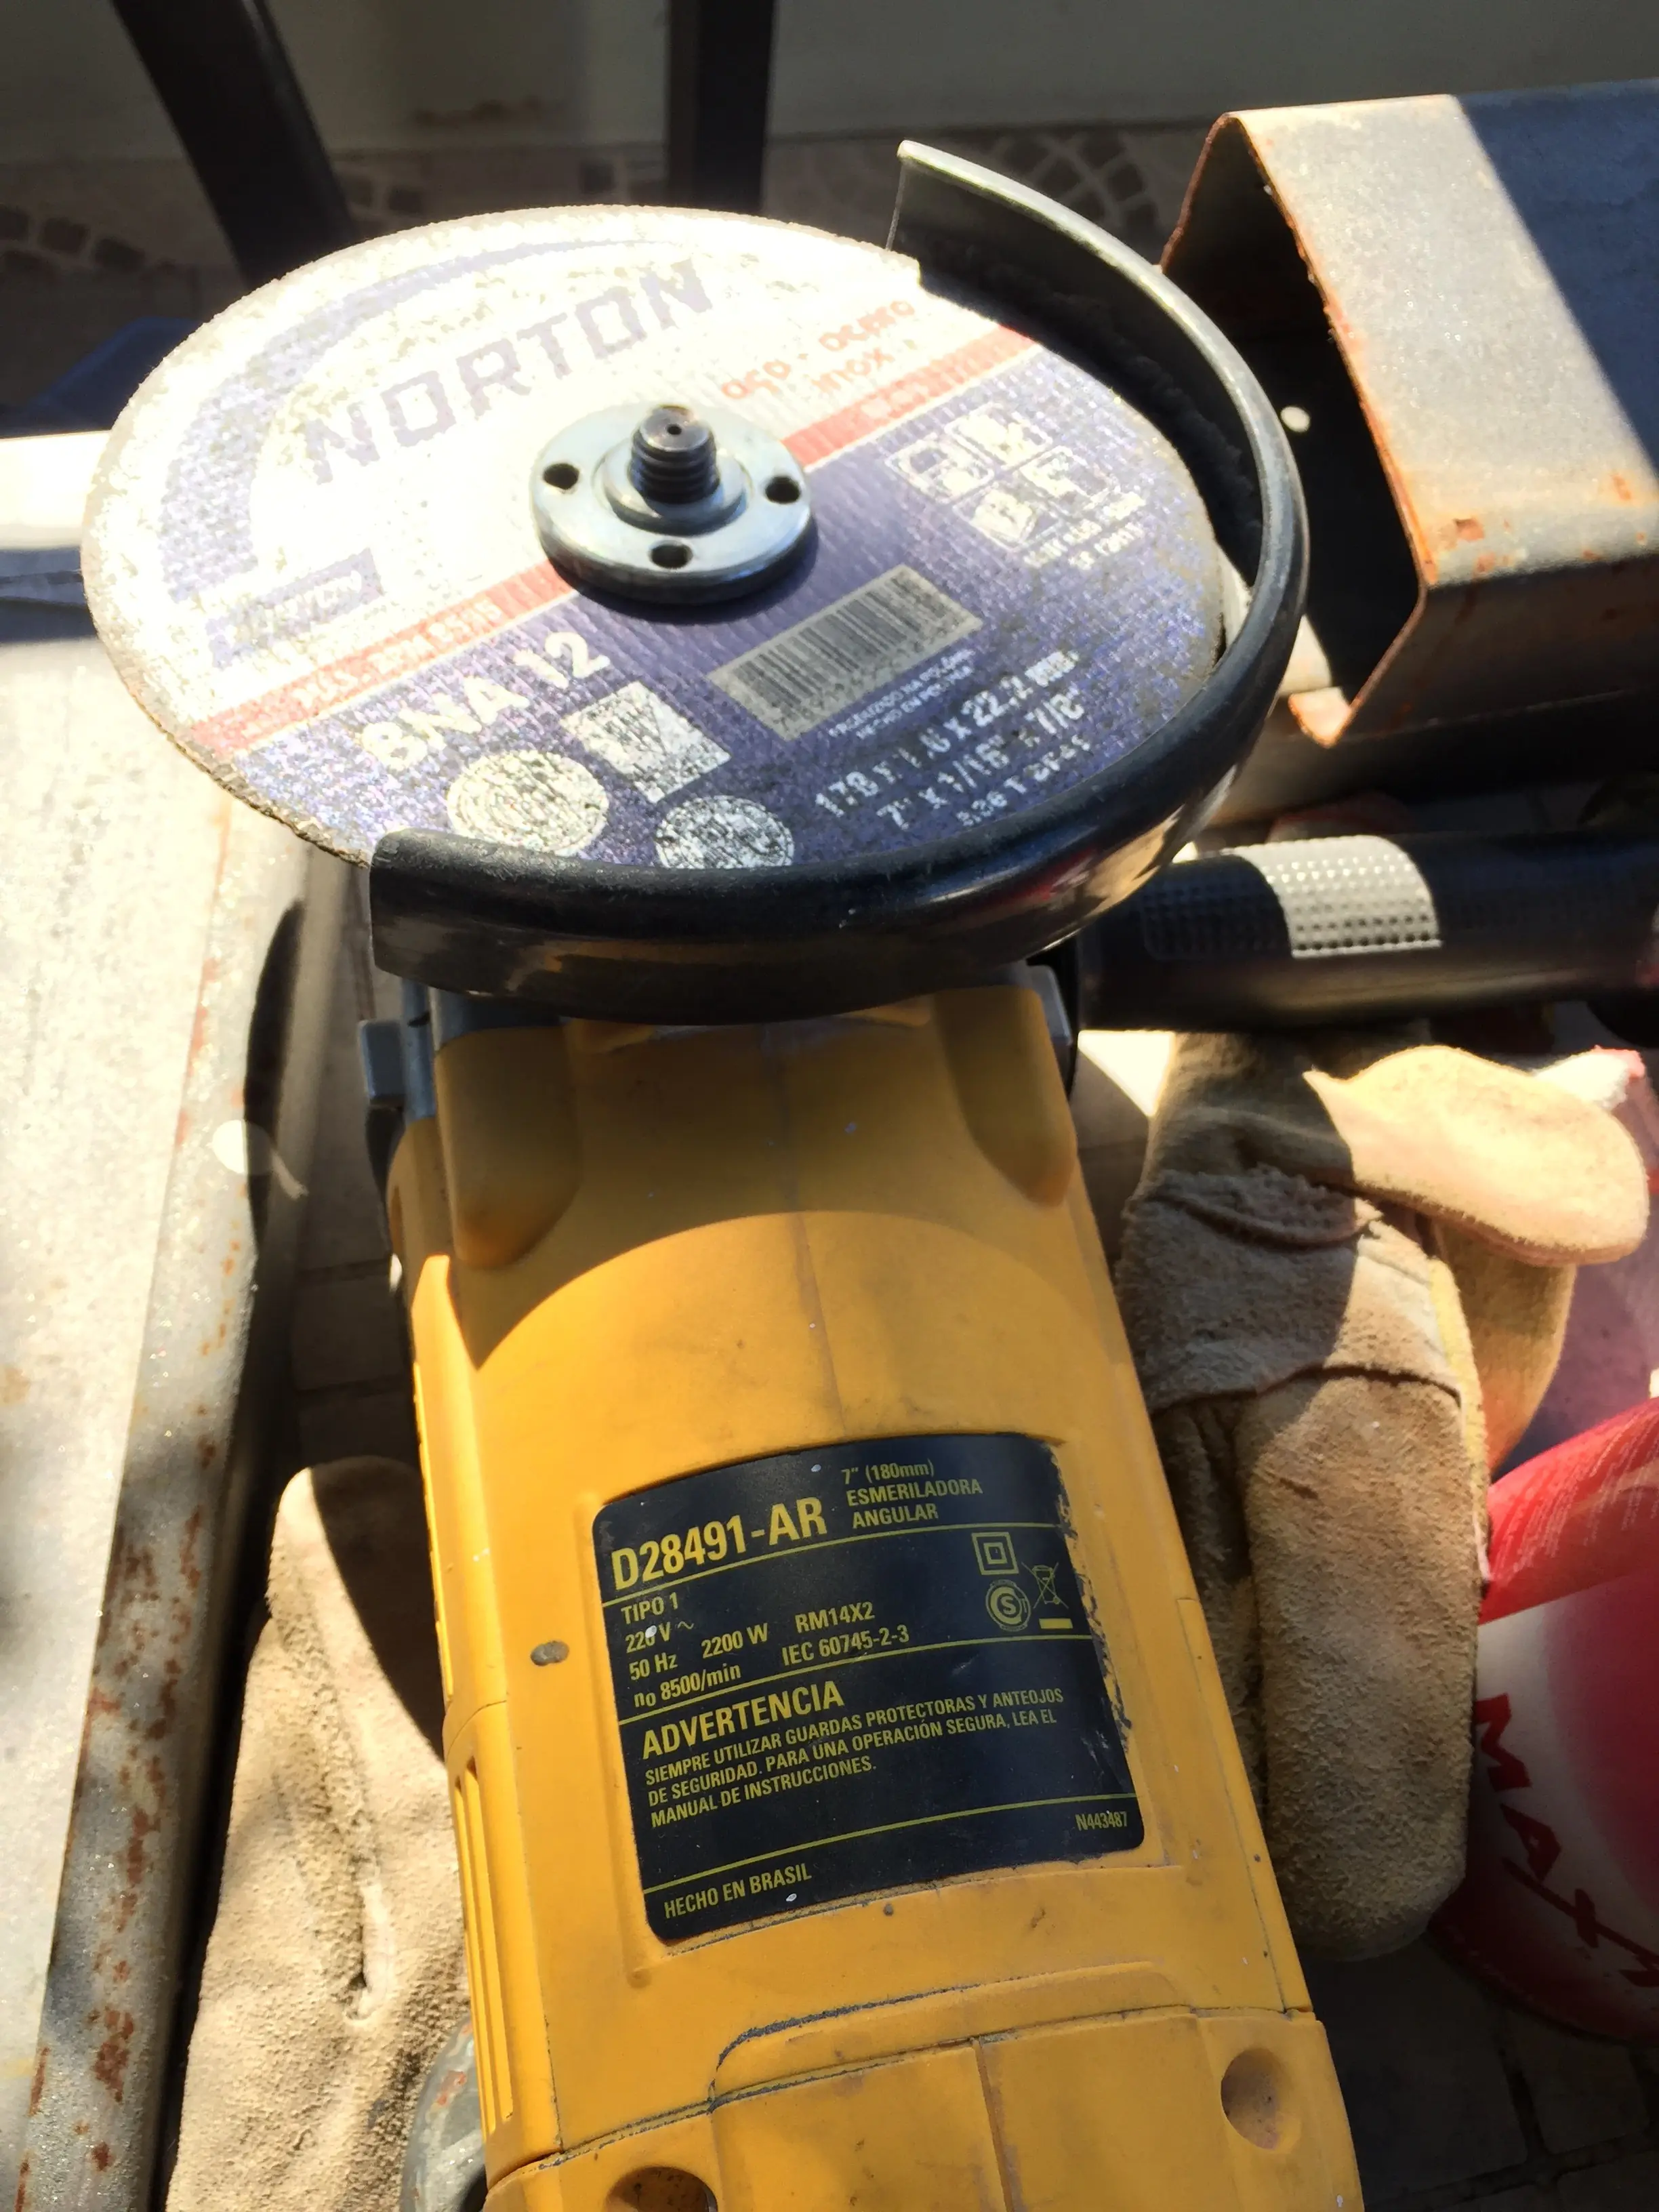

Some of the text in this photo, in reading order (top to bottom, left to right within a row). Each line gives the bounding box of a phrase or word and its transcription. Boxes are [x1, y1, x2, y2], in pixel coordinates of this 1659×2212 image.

[305, 258, 713, 485] NORTON
[841, 1458, 935, 1484] 7" (180mm)
[846, 1479, 983, 1507] ESMERILADORA
[852, 1503, 939, 1529] ANGULAR
[611, 1496, 827, 1589] D28491-AR
[621, 1592, 678, 1624] TIPO 1
[795, 1601, 875, 1631] RM14X2
[701, 1623, 768, 1658] 2200 W
[782, 1624, 909, 1666] IEC 60745-2-3
[629, 1652, 678, 1681] 50 Hz
[660, 1662, 741, 1701] 8500/min
[643, 1681, 844, 1759] ADVERTENCIA
[646, 1688, 1063, 1785] SIEMPRE UTILIZAR GUARDAS PROTECTORAS Y ANTEOJOS
[649, 1708, 1057, 1807] DE SEGURIDAD. PARA UNA OPERACIÓN SEGURA, LEA EL
[651, 1756, 877, 1828] MANUAL DE INSTRUCCIONES.
[1075, 1811, 1127, 1831] N443487
[665, 1863, 812, 1918] HECHO EN BRASIL
